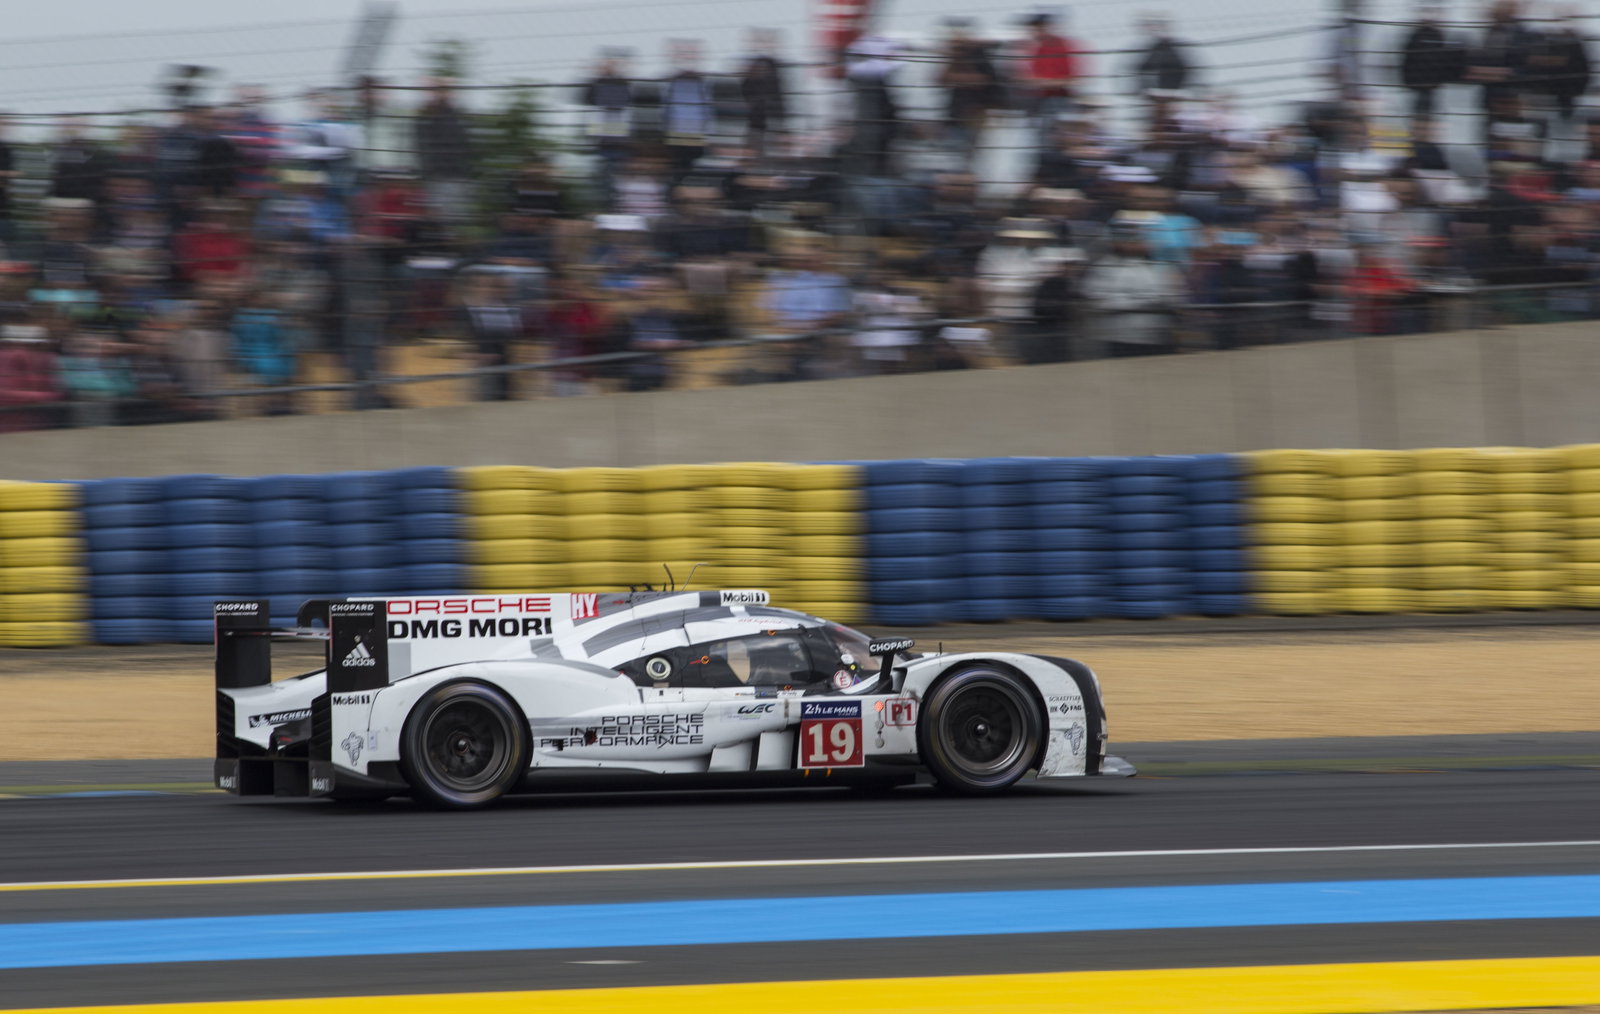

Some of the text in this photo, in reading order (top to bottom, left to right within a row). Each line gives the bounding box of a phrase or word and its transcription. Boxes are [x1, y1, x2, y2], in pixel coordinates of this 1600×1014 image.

[723, 592, 754, 602] Mobil
[216, 603, 259, 611] CHOPARD
[388, 598, 551, 614] ORSCHE
[572, 594, 597, 619] HY
[388, 618, 552, 638] DMG MORI
[869, 640, 914, 652] CHOPARD
[342, 658, 376, 667] adidas
[333, 695, 360, 705] Mobil
[738, 703, 776, 714] WEC
[834, 706, 858, 714] MANS
[892, 703, 911, 721] P1
[269, 709, 313, 723] MICHELI
[602, 714, 704, 725] PORSCHE
[570, 724, 704, 736] INTELLIGENT
[809, 722, 855, 762] 19
